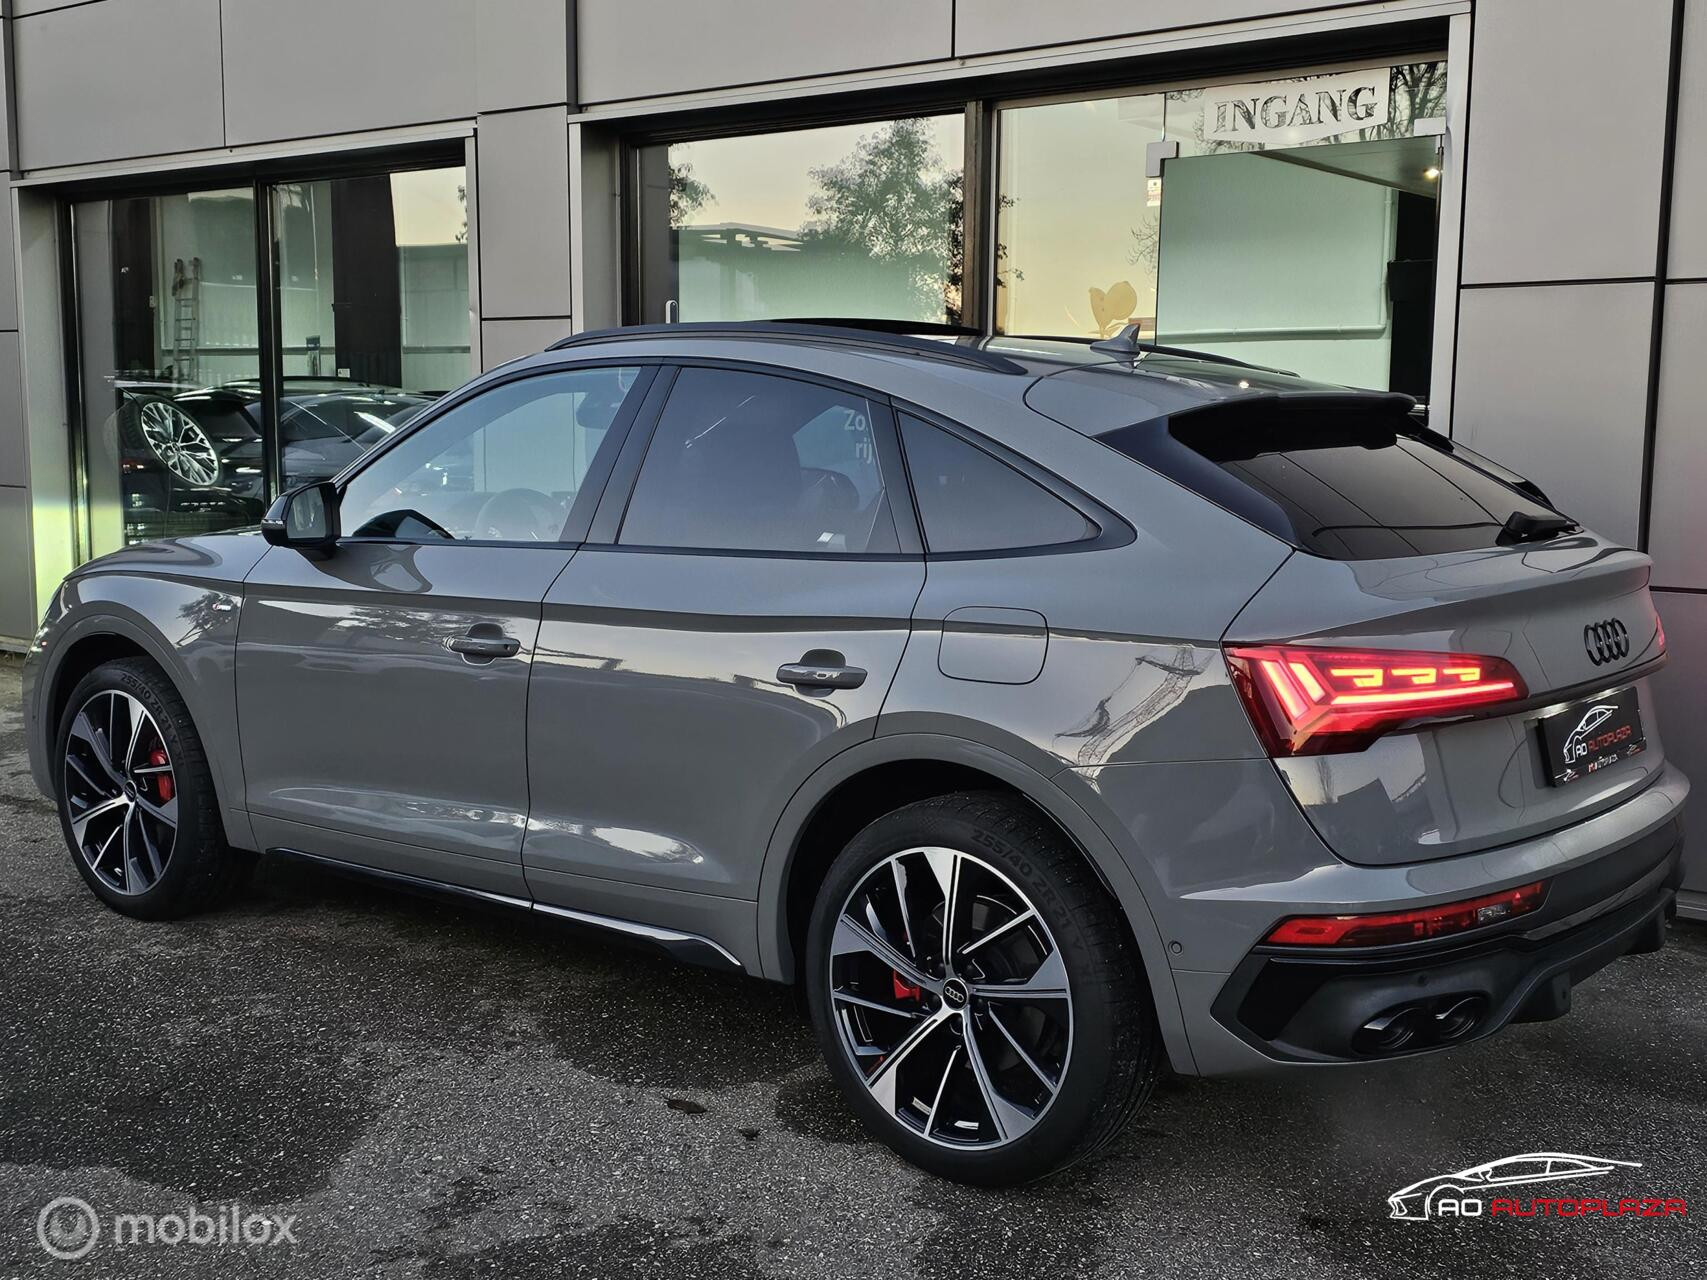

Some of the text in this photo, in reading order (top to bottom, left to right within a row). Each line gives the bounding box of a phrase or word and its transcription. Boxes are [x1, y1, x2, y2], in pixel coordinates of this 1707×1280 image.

[1213, 86, 1378, 134] INGANG
[121, 673, 152, 700] 255/40
[1575, 742, 1588, 758] AO
[970, 829, 1033, 877] 255/40
